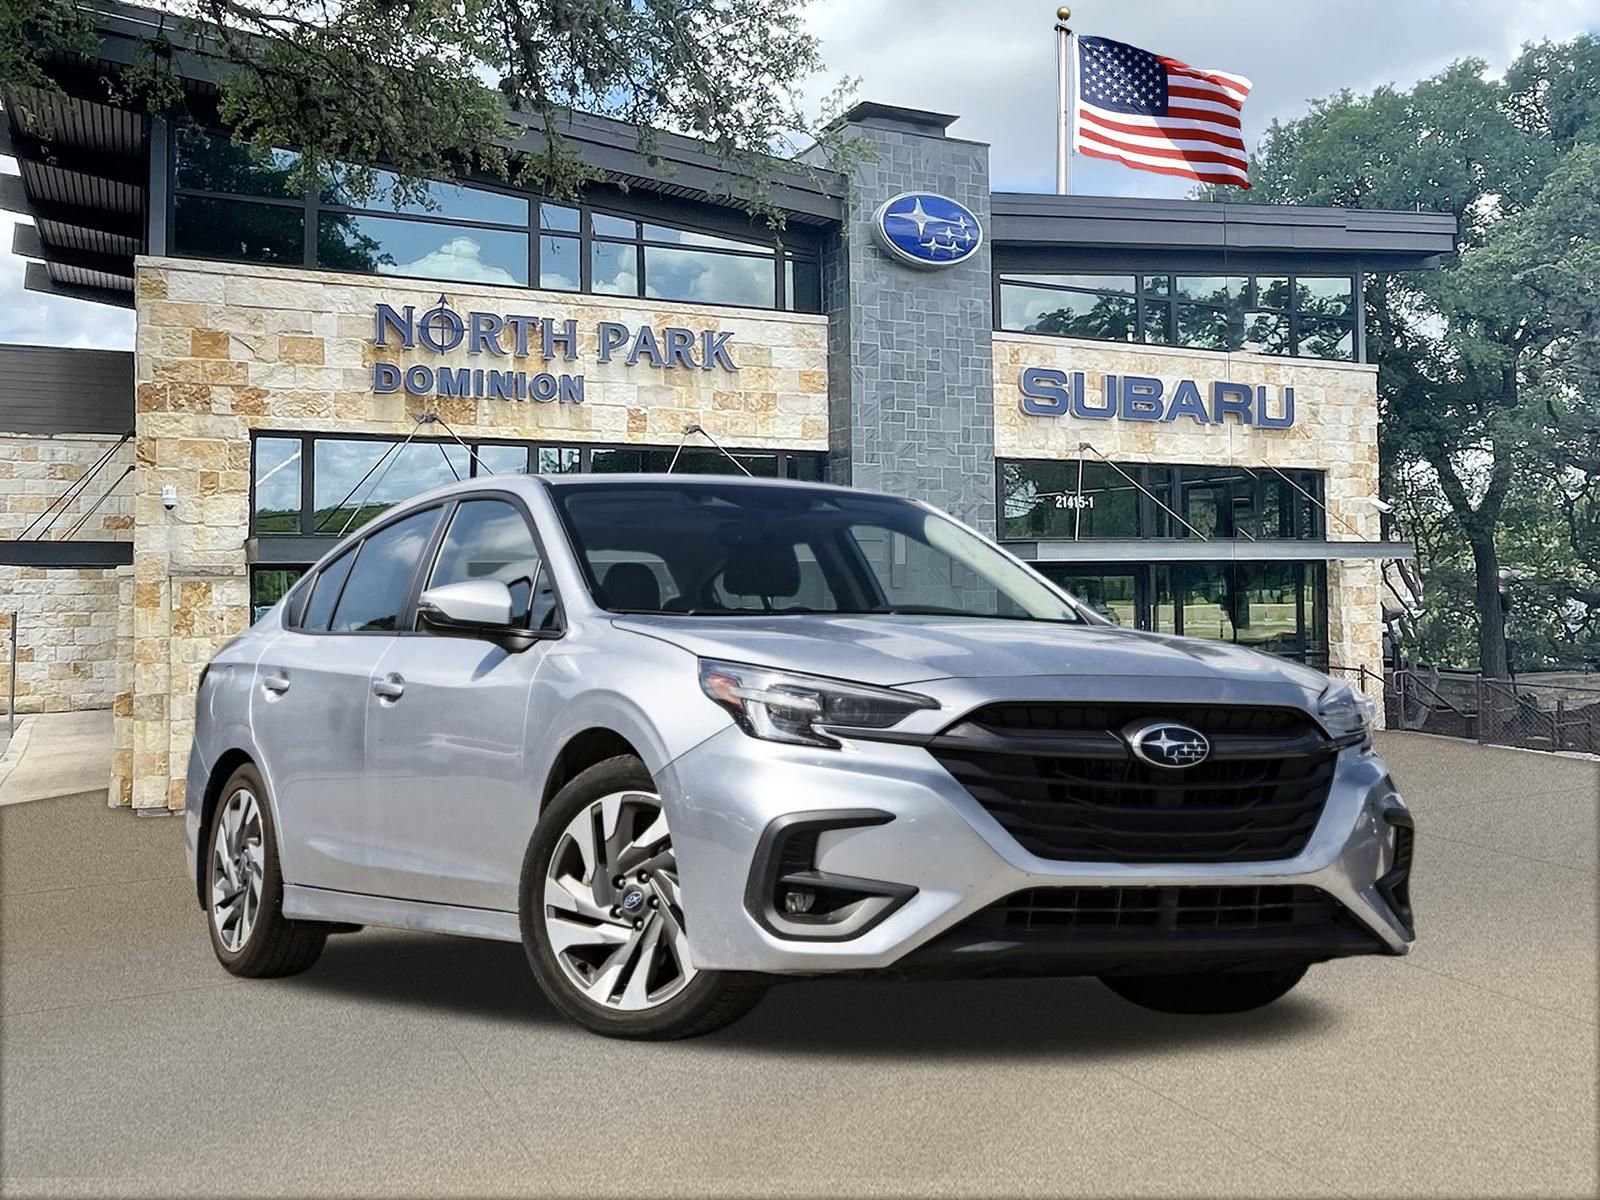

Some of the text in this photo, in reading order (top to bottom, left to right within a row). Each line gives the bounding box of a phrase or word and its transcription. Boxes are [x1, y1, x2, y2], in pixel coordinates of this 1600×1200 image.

[374, 303, 740, 373] NORTH PARK
[373, 362, 584, 403] DOMINION
[1019, 367, 1295, 429] SUBARU
